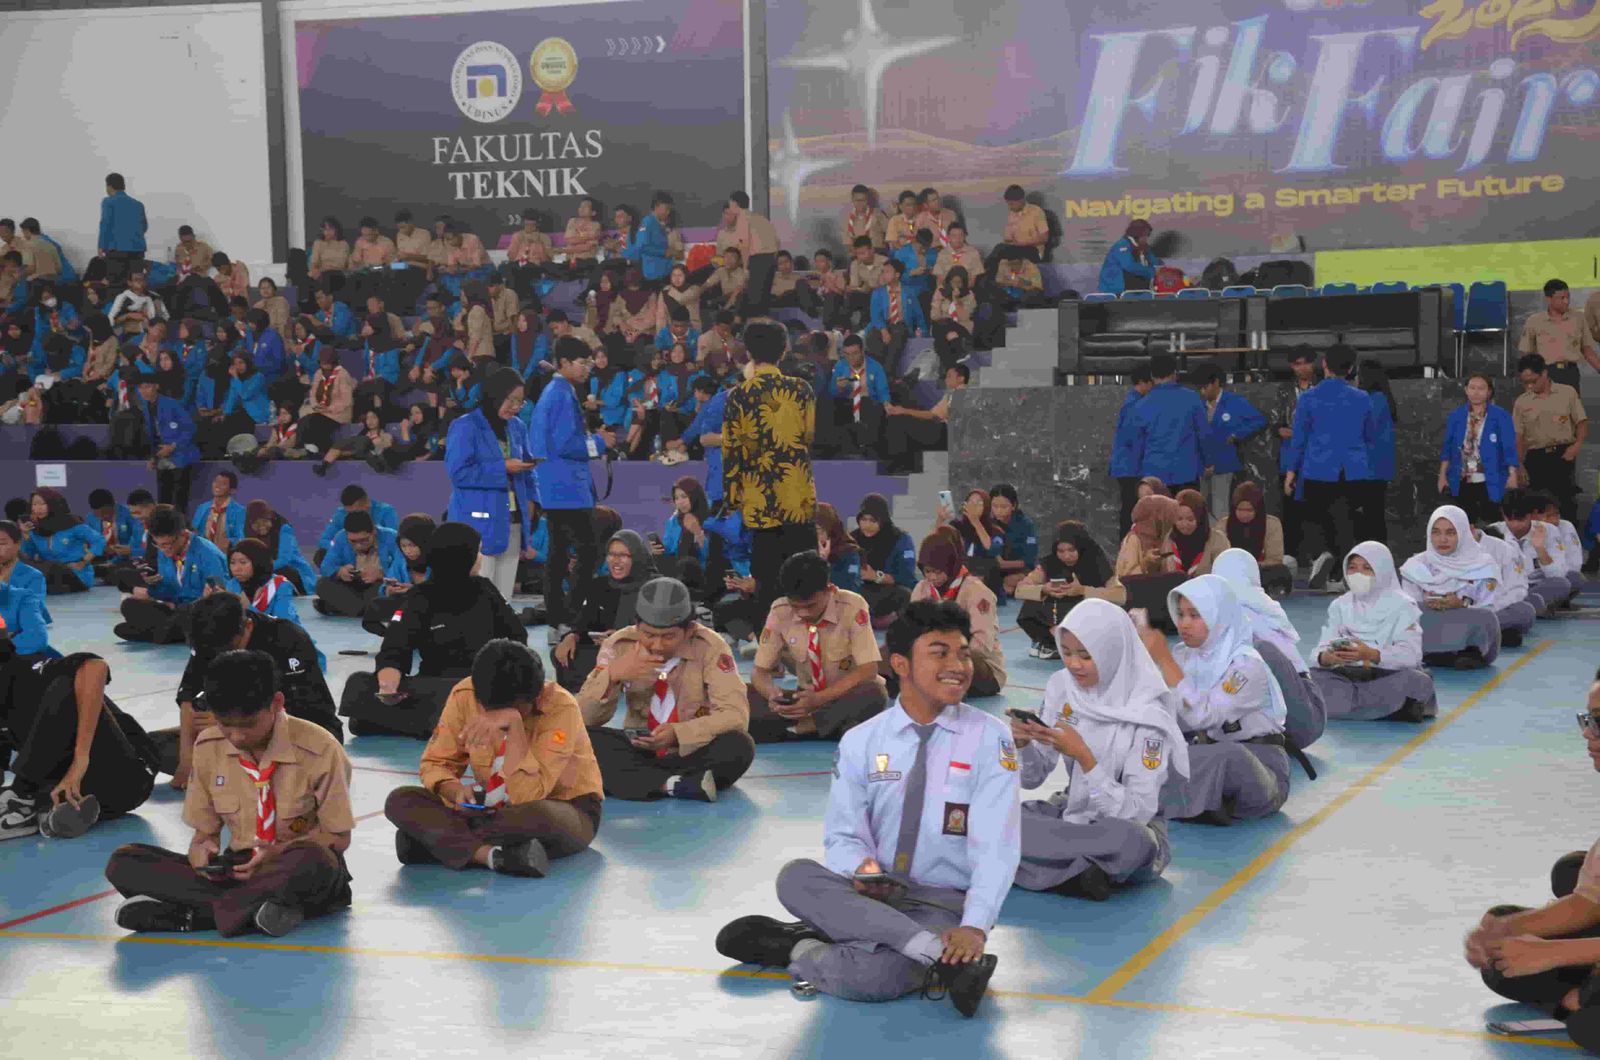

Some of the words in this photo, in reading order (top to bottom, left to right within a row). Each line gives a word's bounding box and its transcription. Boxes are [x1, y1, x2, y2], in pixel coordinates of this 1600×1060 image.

[432, 129, 603, 165] FAKULTAS
[448, 166, 588, 200] TEKNIK
[1065, 191, 1235, 220] Navigating
[1244, 192, 1265, 210] a
[1274, 181, 1427, 208] Smarter
[1437, 174, 1565, 199] Future
